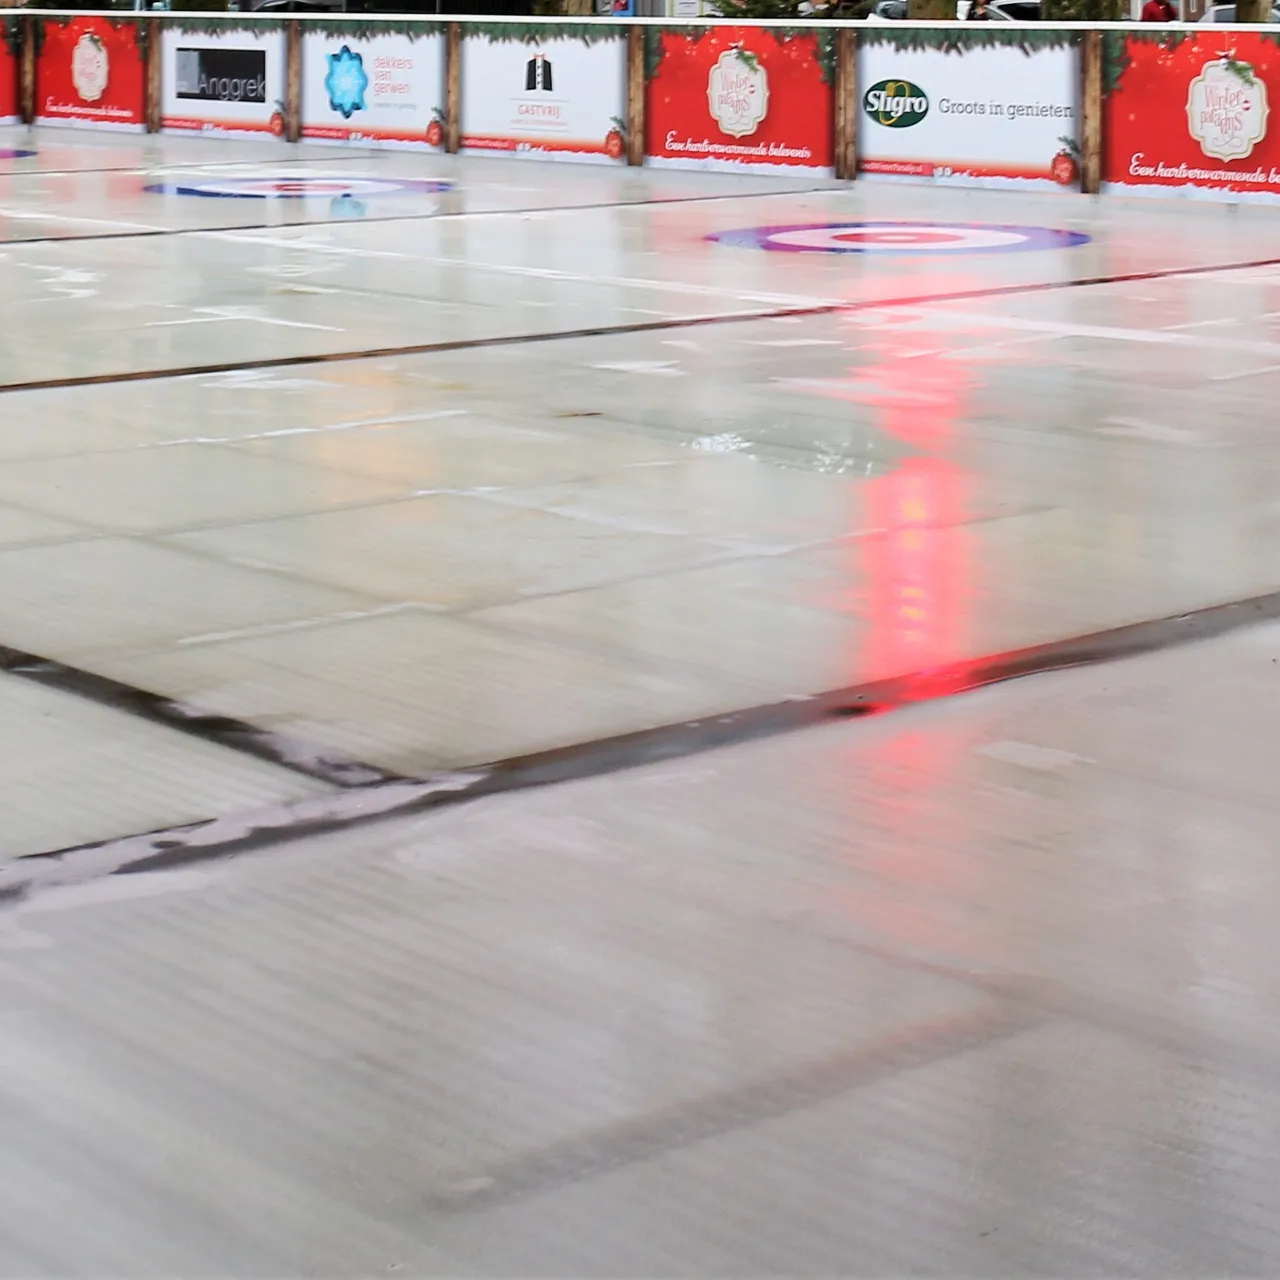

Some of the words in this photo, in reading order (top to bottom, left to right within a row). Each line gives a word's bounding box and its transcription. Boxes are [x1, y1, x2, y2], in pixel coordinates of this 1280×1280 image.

[373, 56, 413, 69] dekkers
[374, 70, 392, 81] van
[199, 73, 265, 101] Anggrek
[373, 83, 410, 96] gerwen
[1204, 83, 1244, 110] Winter
[517, 104, 560, 118] GASTVRIJ
[865, 90, 927, 117] Sligro
[938, 98, 986, 116] Groots
[988, 99, 1004, 115] in
[664, 131, 685, 151] Een
[768, 141, 813, 159] belevenis
[1129, 152, 1156, 177] Een
[1156, 161, 1266, 184] hartverwarmende
